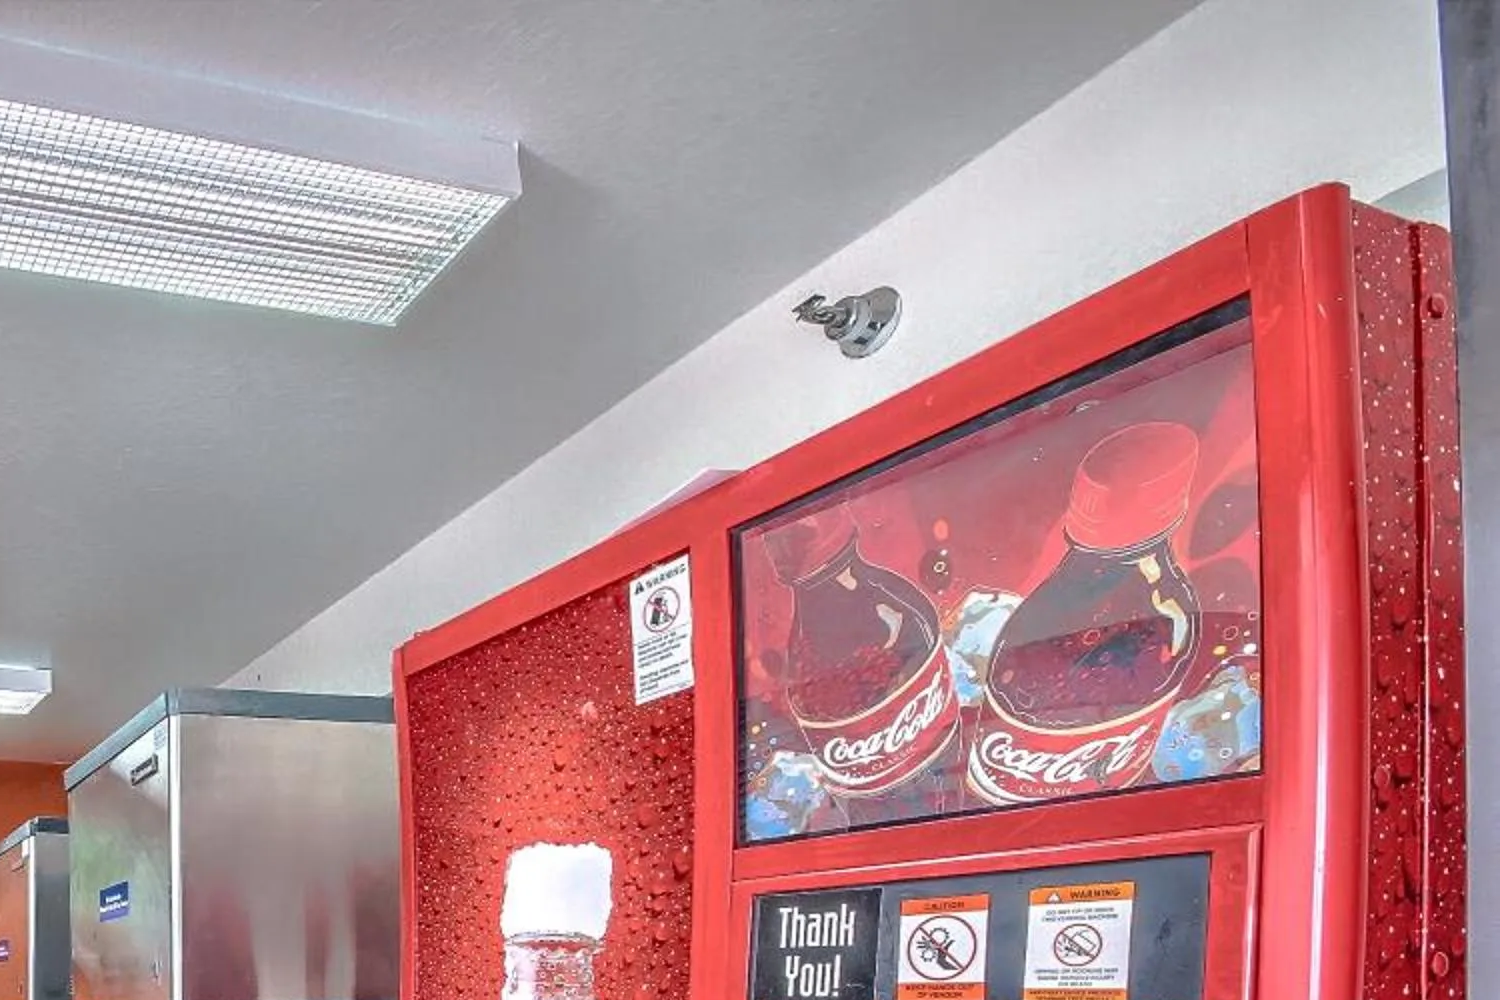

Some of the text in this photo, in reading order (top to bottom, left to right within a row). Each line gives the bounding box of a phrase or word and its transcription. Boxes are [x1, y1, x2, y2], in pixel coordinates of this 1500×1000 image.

[923, 901, 965, 910] CAUTION
[1070, 887, 1121, 899] WARNING
[779, 903, 856, 948] Thank
[785, 955, 841, 997] You!
